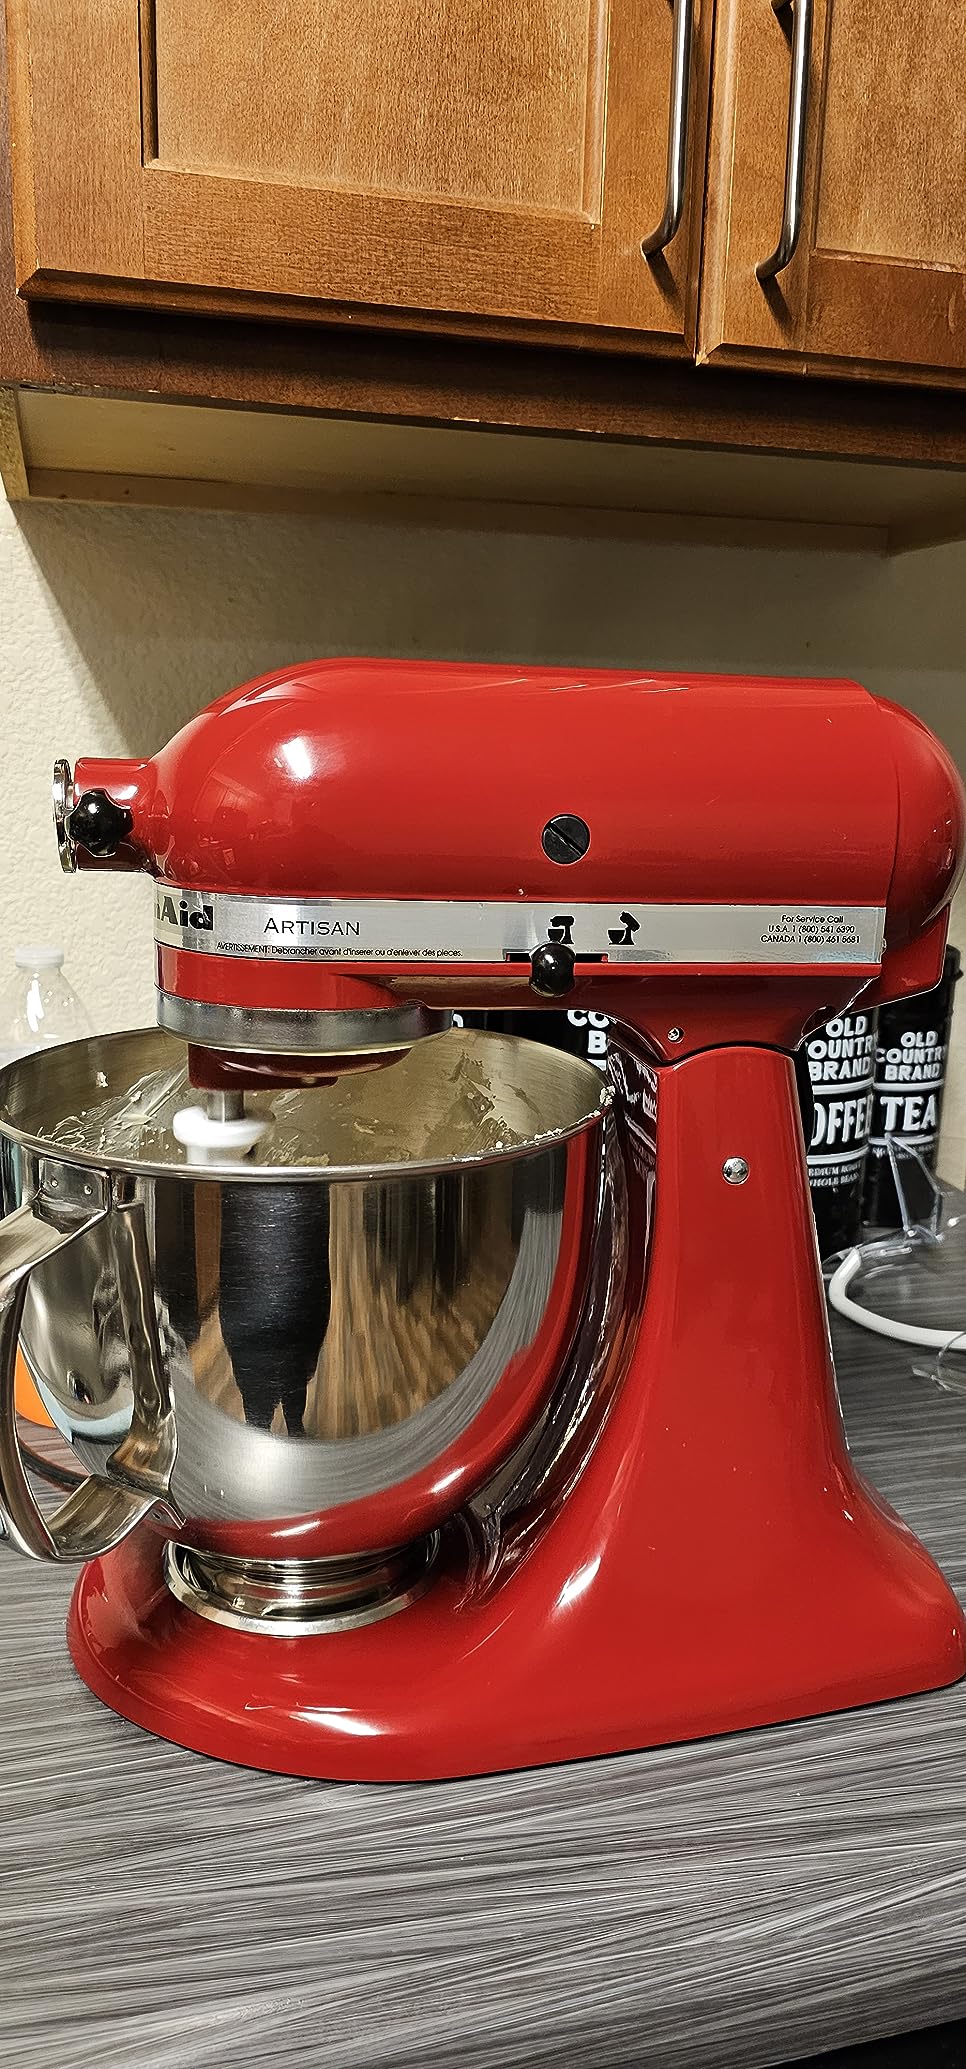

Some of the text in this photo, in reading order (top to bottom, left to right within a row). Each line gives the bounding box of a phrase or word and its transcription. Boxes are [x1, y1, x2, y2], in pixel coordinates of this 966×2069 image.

[264, 917, 361, 937] ARTISAN
[781, 915, 844, 924] For Service Call
[768, 925, 790, 933] U.S.A.
[798, 925, 819, 935] (800)
[819, 925, 834, 934] 541
[835, 926, 855, 934] 6390
[760, 935, 796, 943] CANADA
[803, 935, 825, 945] (800)
[825, 936, 840, 944] 461
[375, 949, 386, 957] ou
[421, 949, 436, 957] des
[825, 1016, 867, 1038] OLD
[900, 1031, 938, 1048] OLD
[807, 1056, 872, 1082] BRAND
[884, 1063, 941, 1081] BRAND
[879, 1094, 937, 1132] TEA
